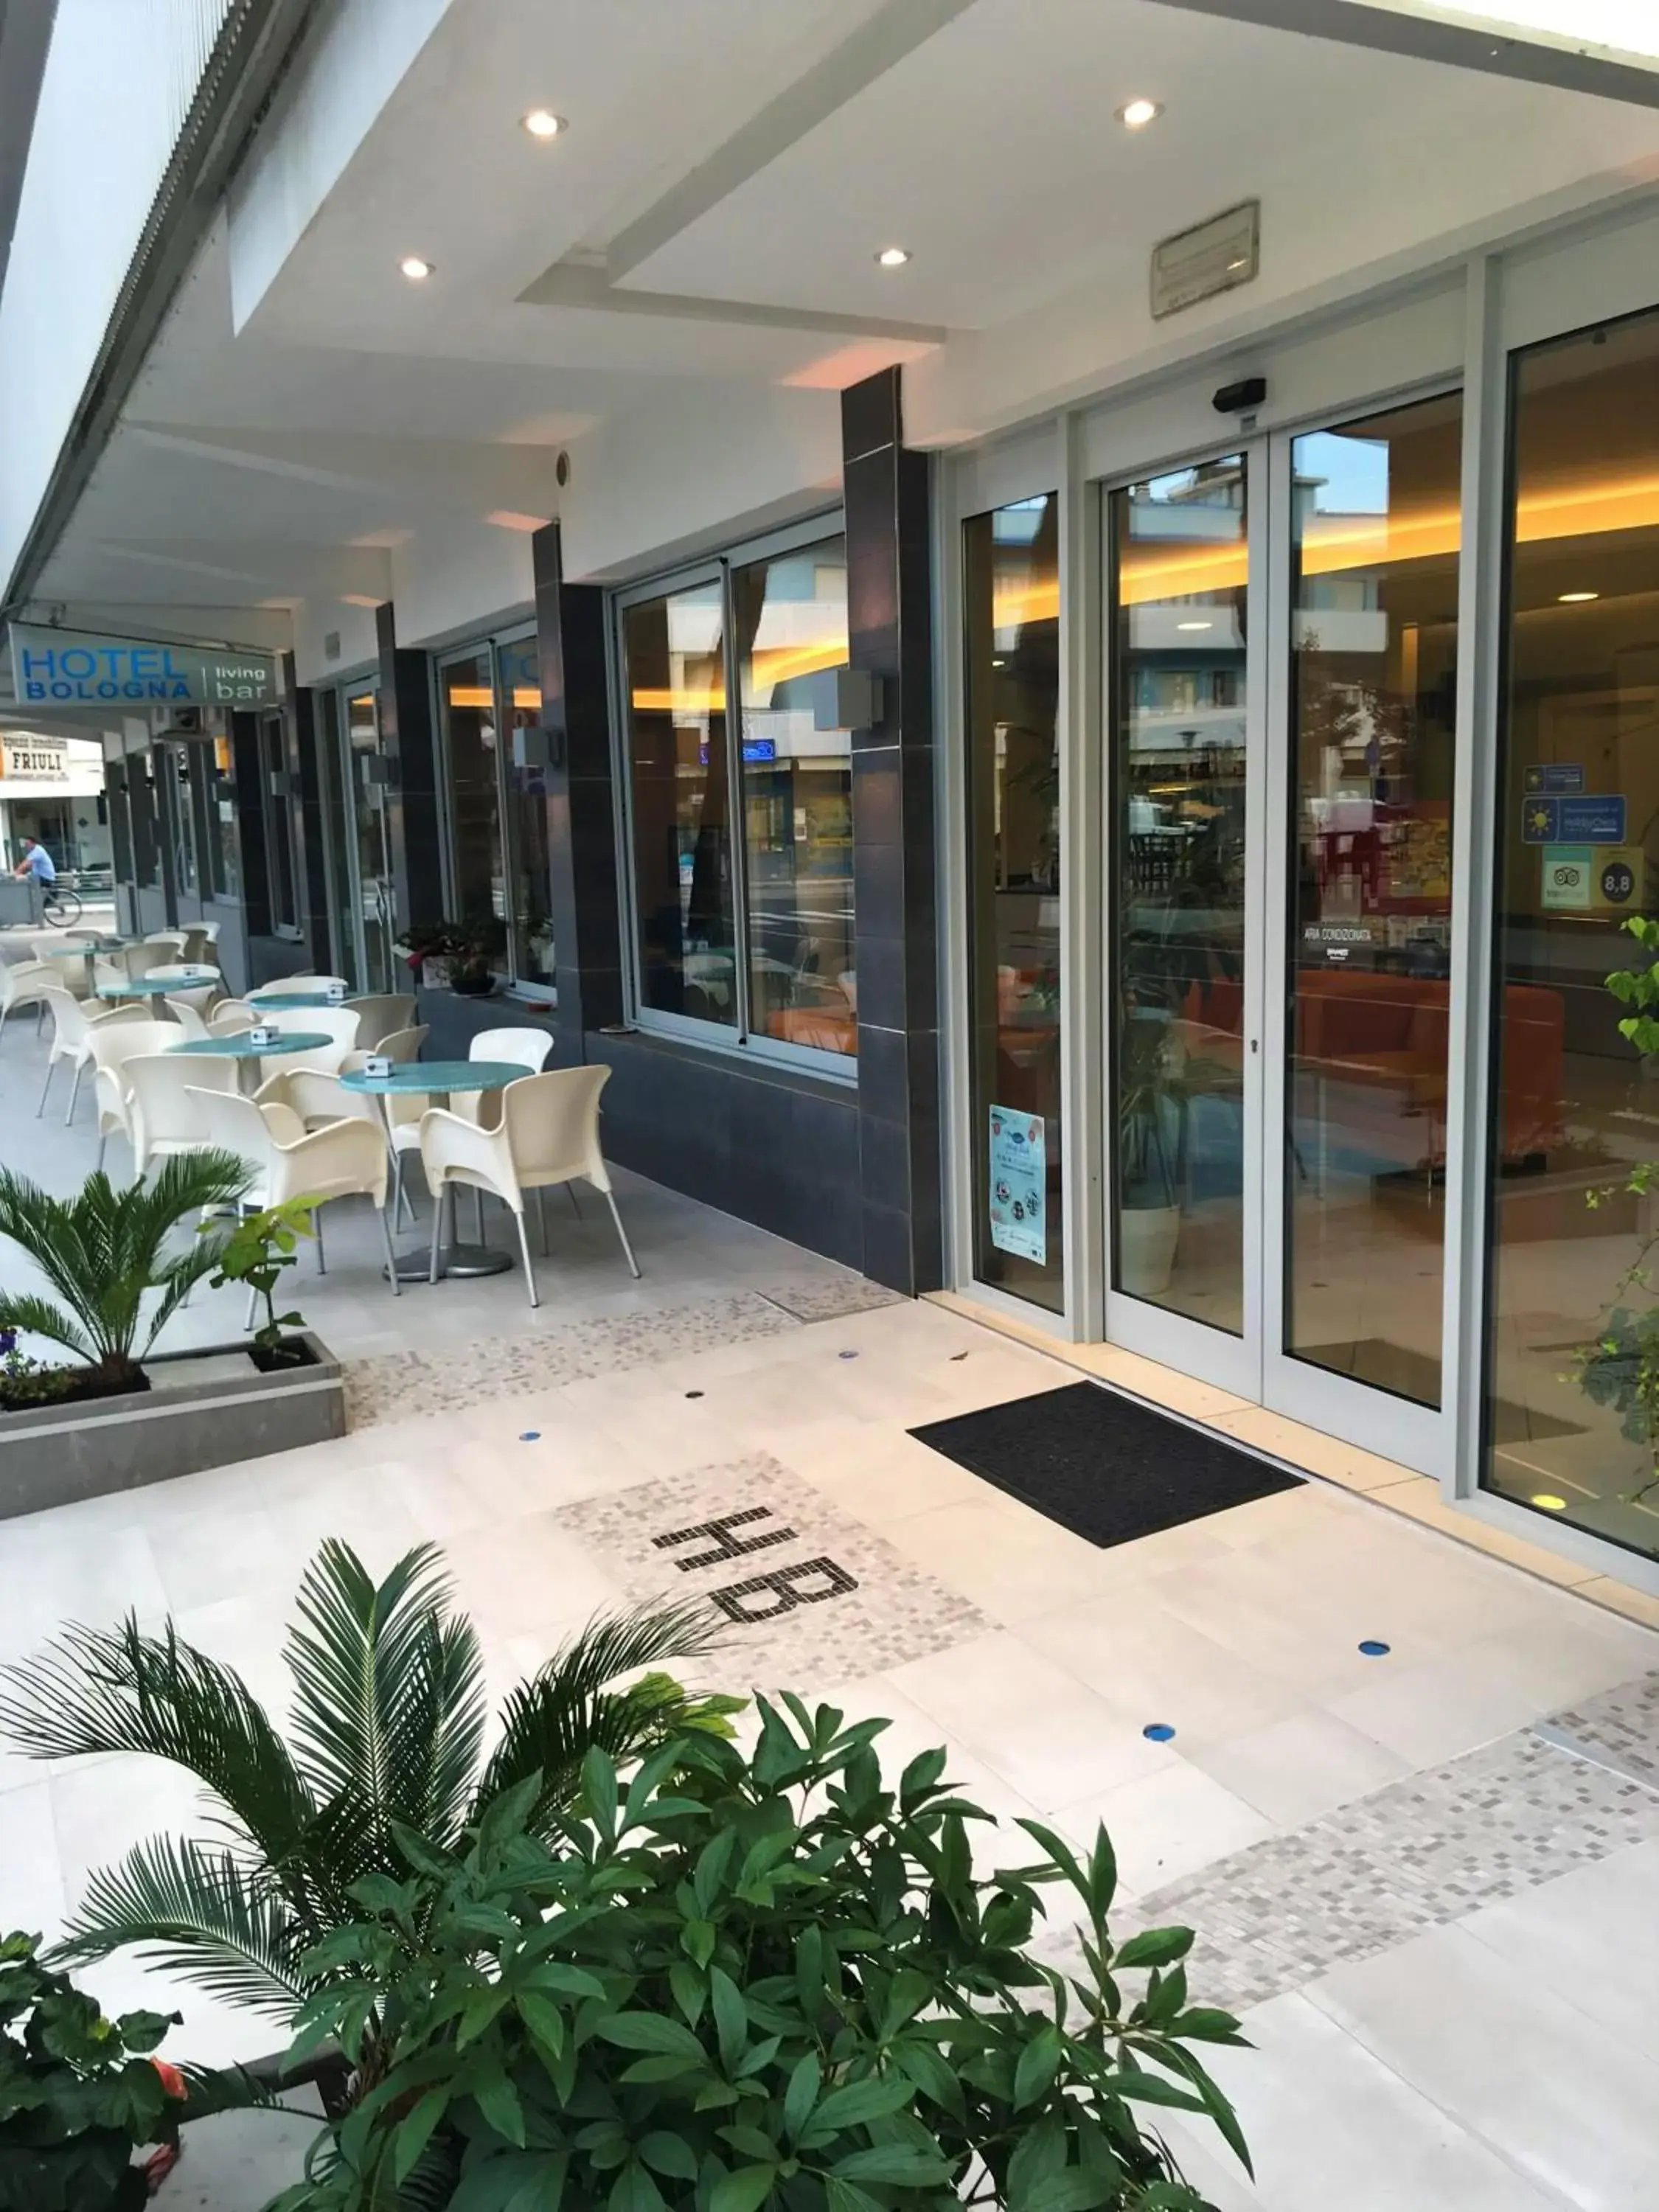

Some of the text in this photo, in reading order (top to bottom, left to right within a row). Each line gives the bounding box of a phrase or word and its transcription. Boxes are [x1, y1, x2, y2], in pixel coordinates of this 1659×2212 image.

[22, 648, 188, 680] HOTEL
[215, 667, 266, 681] living
[27, 682, 192, 700] BOLOGNA
[217, 683, 267, 700] bar
[13, 751, 63, 771] FRIULI
[650, 1506, 860, 1624] HB
